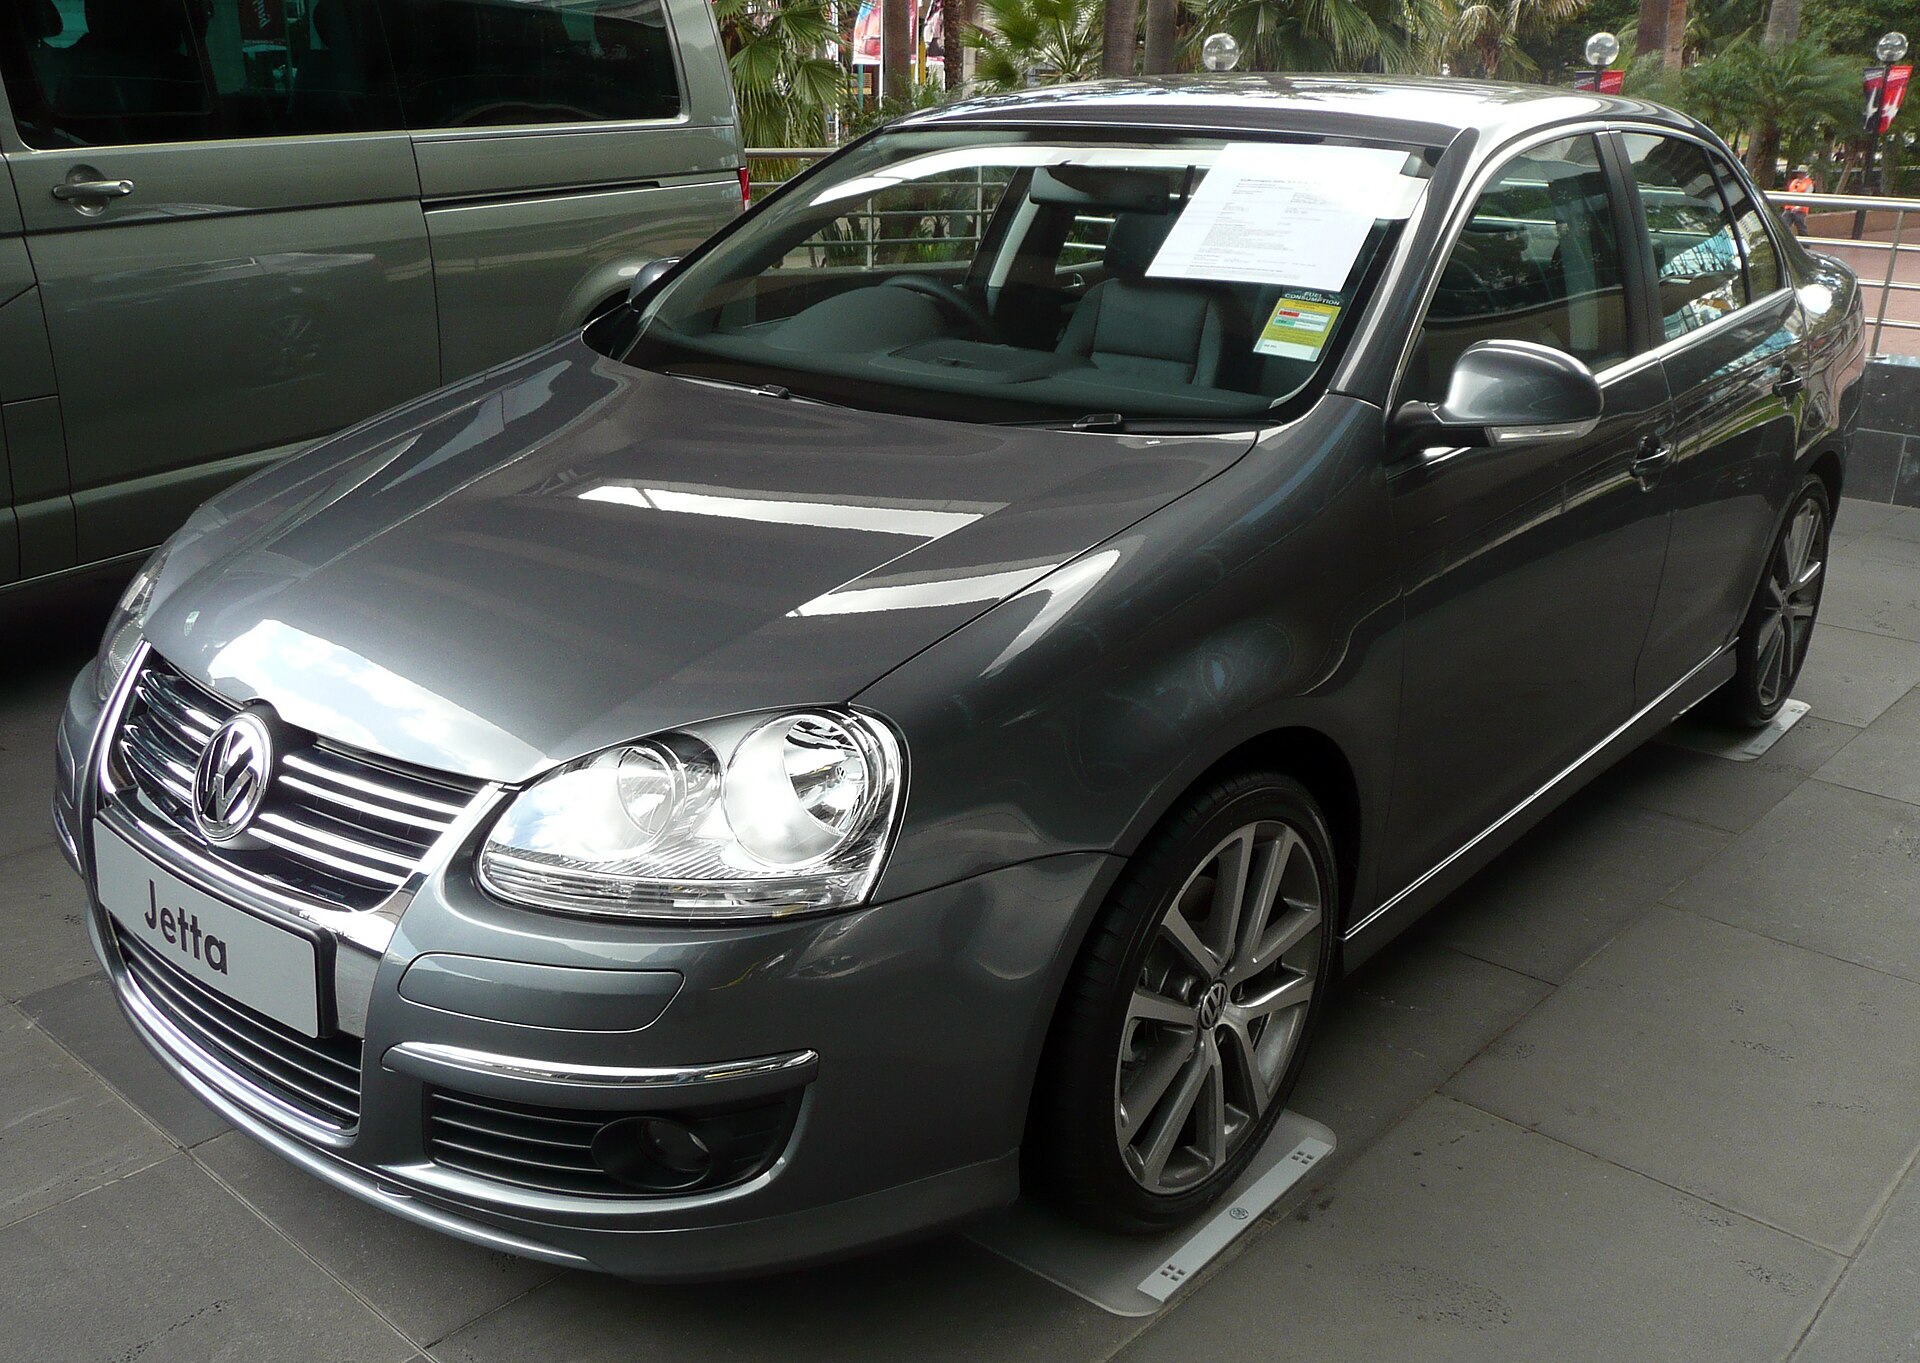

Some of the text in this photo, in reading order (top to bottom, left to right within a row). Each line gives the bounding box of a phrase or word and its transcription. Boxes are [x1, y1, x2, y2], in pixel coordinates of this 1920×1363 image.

[1284, 293, 1340, 306] CONSUMPTION
[1304, 291, 1322, 299] FUEL
[144, 878, 228, 976] Jetta
